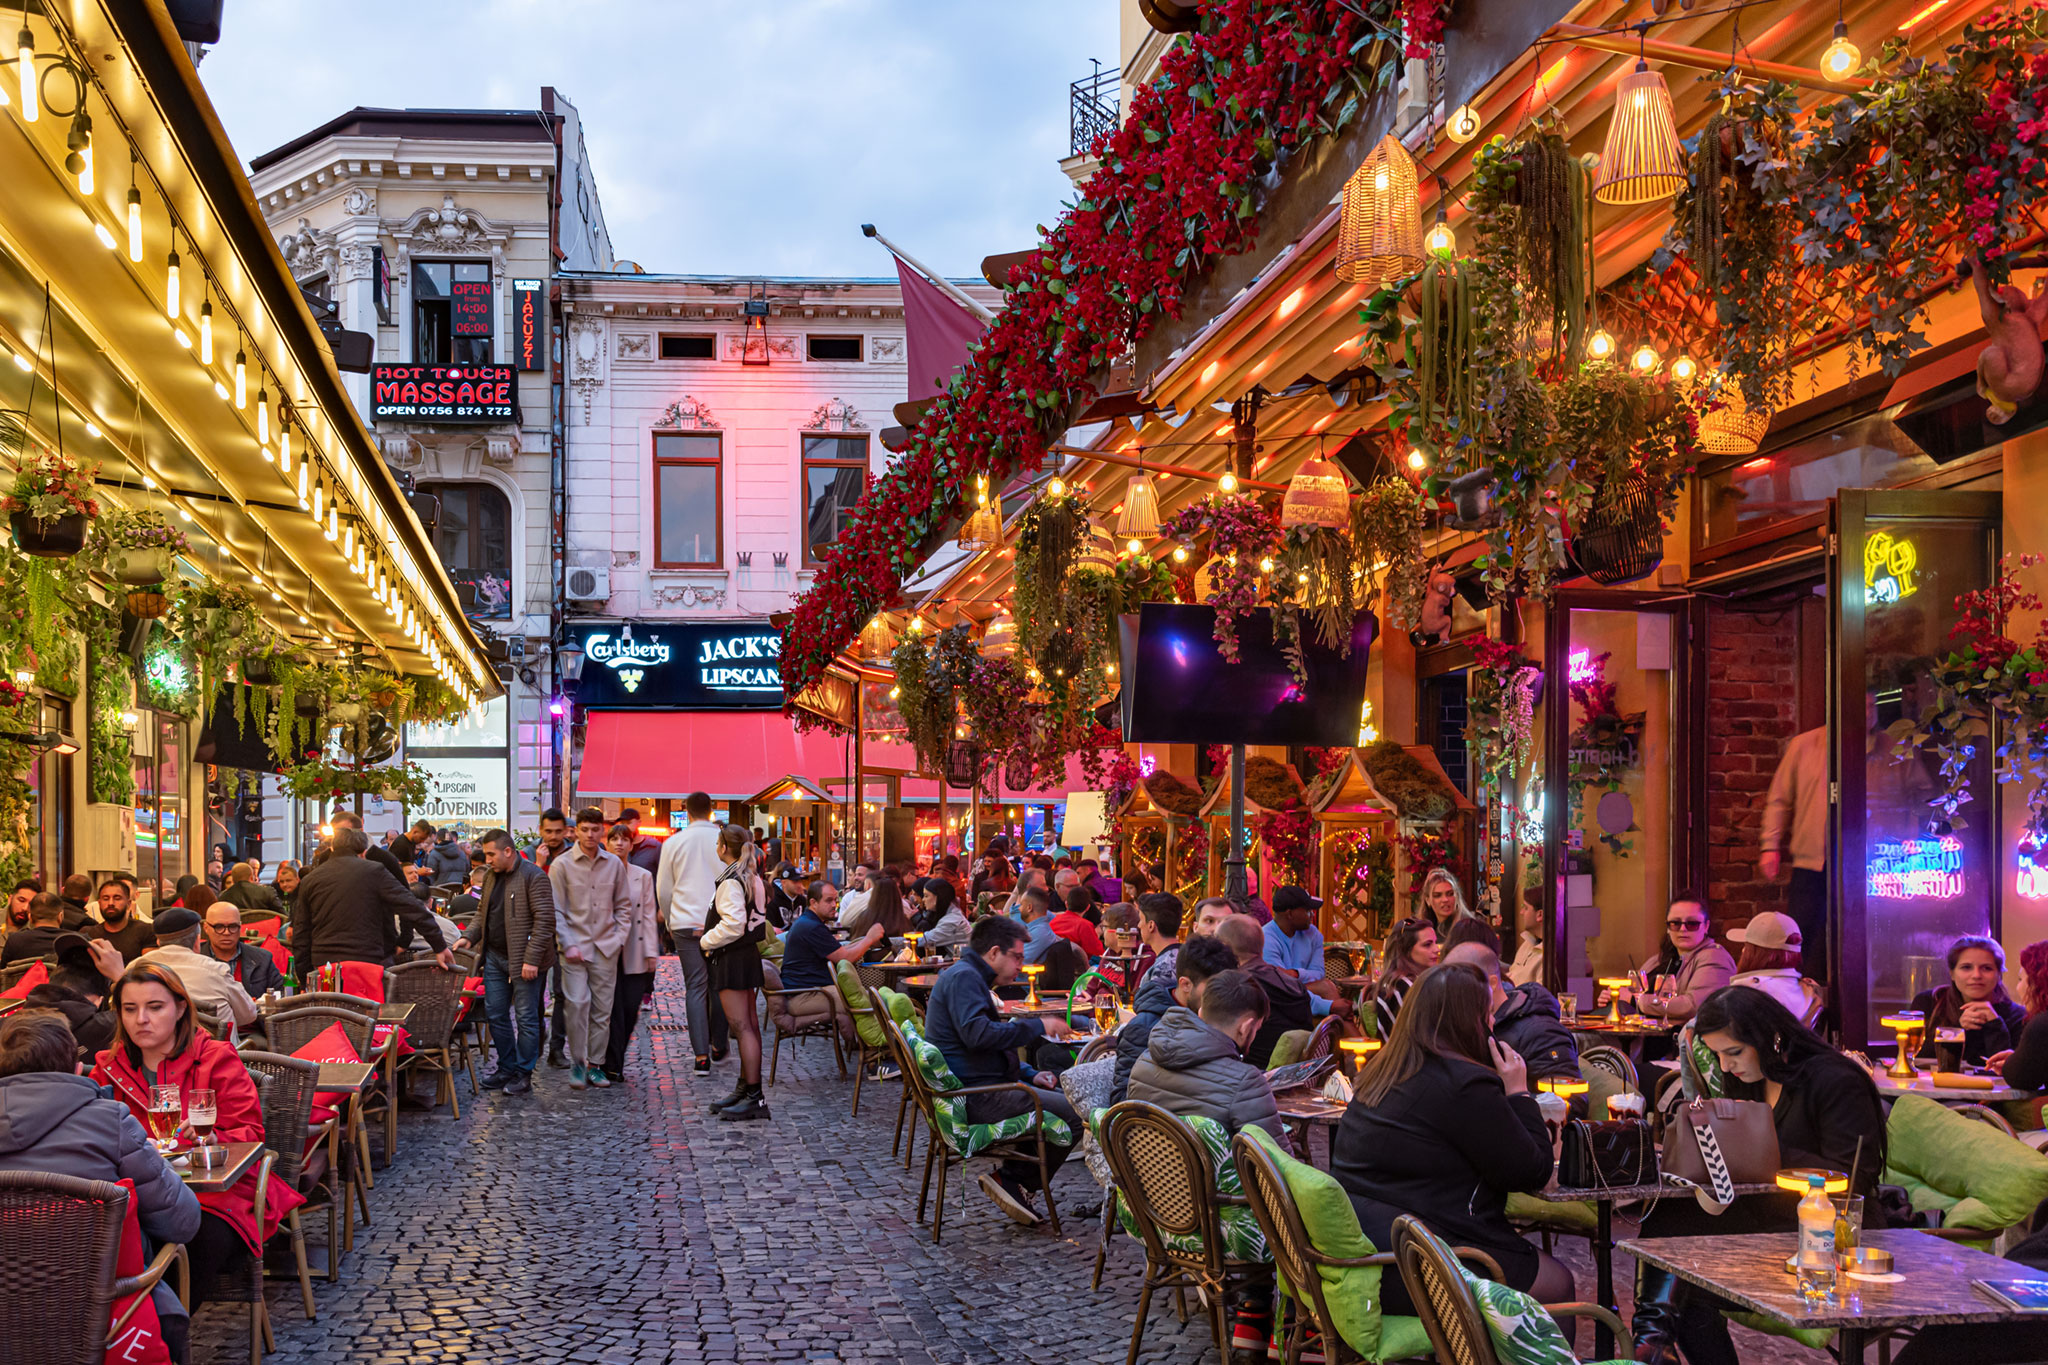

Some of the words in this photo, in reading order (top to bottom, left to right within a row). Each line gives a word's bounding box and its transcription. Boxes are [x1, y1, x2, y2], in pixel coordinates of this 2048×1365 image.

[453, 284, 491, 295] OPEN
[456, 303, 488, 313] 14:00
[456, 323, 489, 333] 06:00
[522, 291, 534, 369] JACUZZI
[376, 368, 424, 379] HOT
[431, 368, 511, 379] TOUCH
[376, 382, 511, 404] MASSAGE
[376, 406, 416, 415] OPEN
[419, 407, 453, 415] 0756
[456, 407, 483, 415] 874
[486, 407, 512, 416] 772
[586, 634, 670, 664] Carlsberg
[699, 636, 783, 663] JACK'S
[701, 668, 783, 685] LIPSCAN
[437, 782, 476, 793] LIPSCANI
[417, 801, 498, 816] SOUVENIRS
